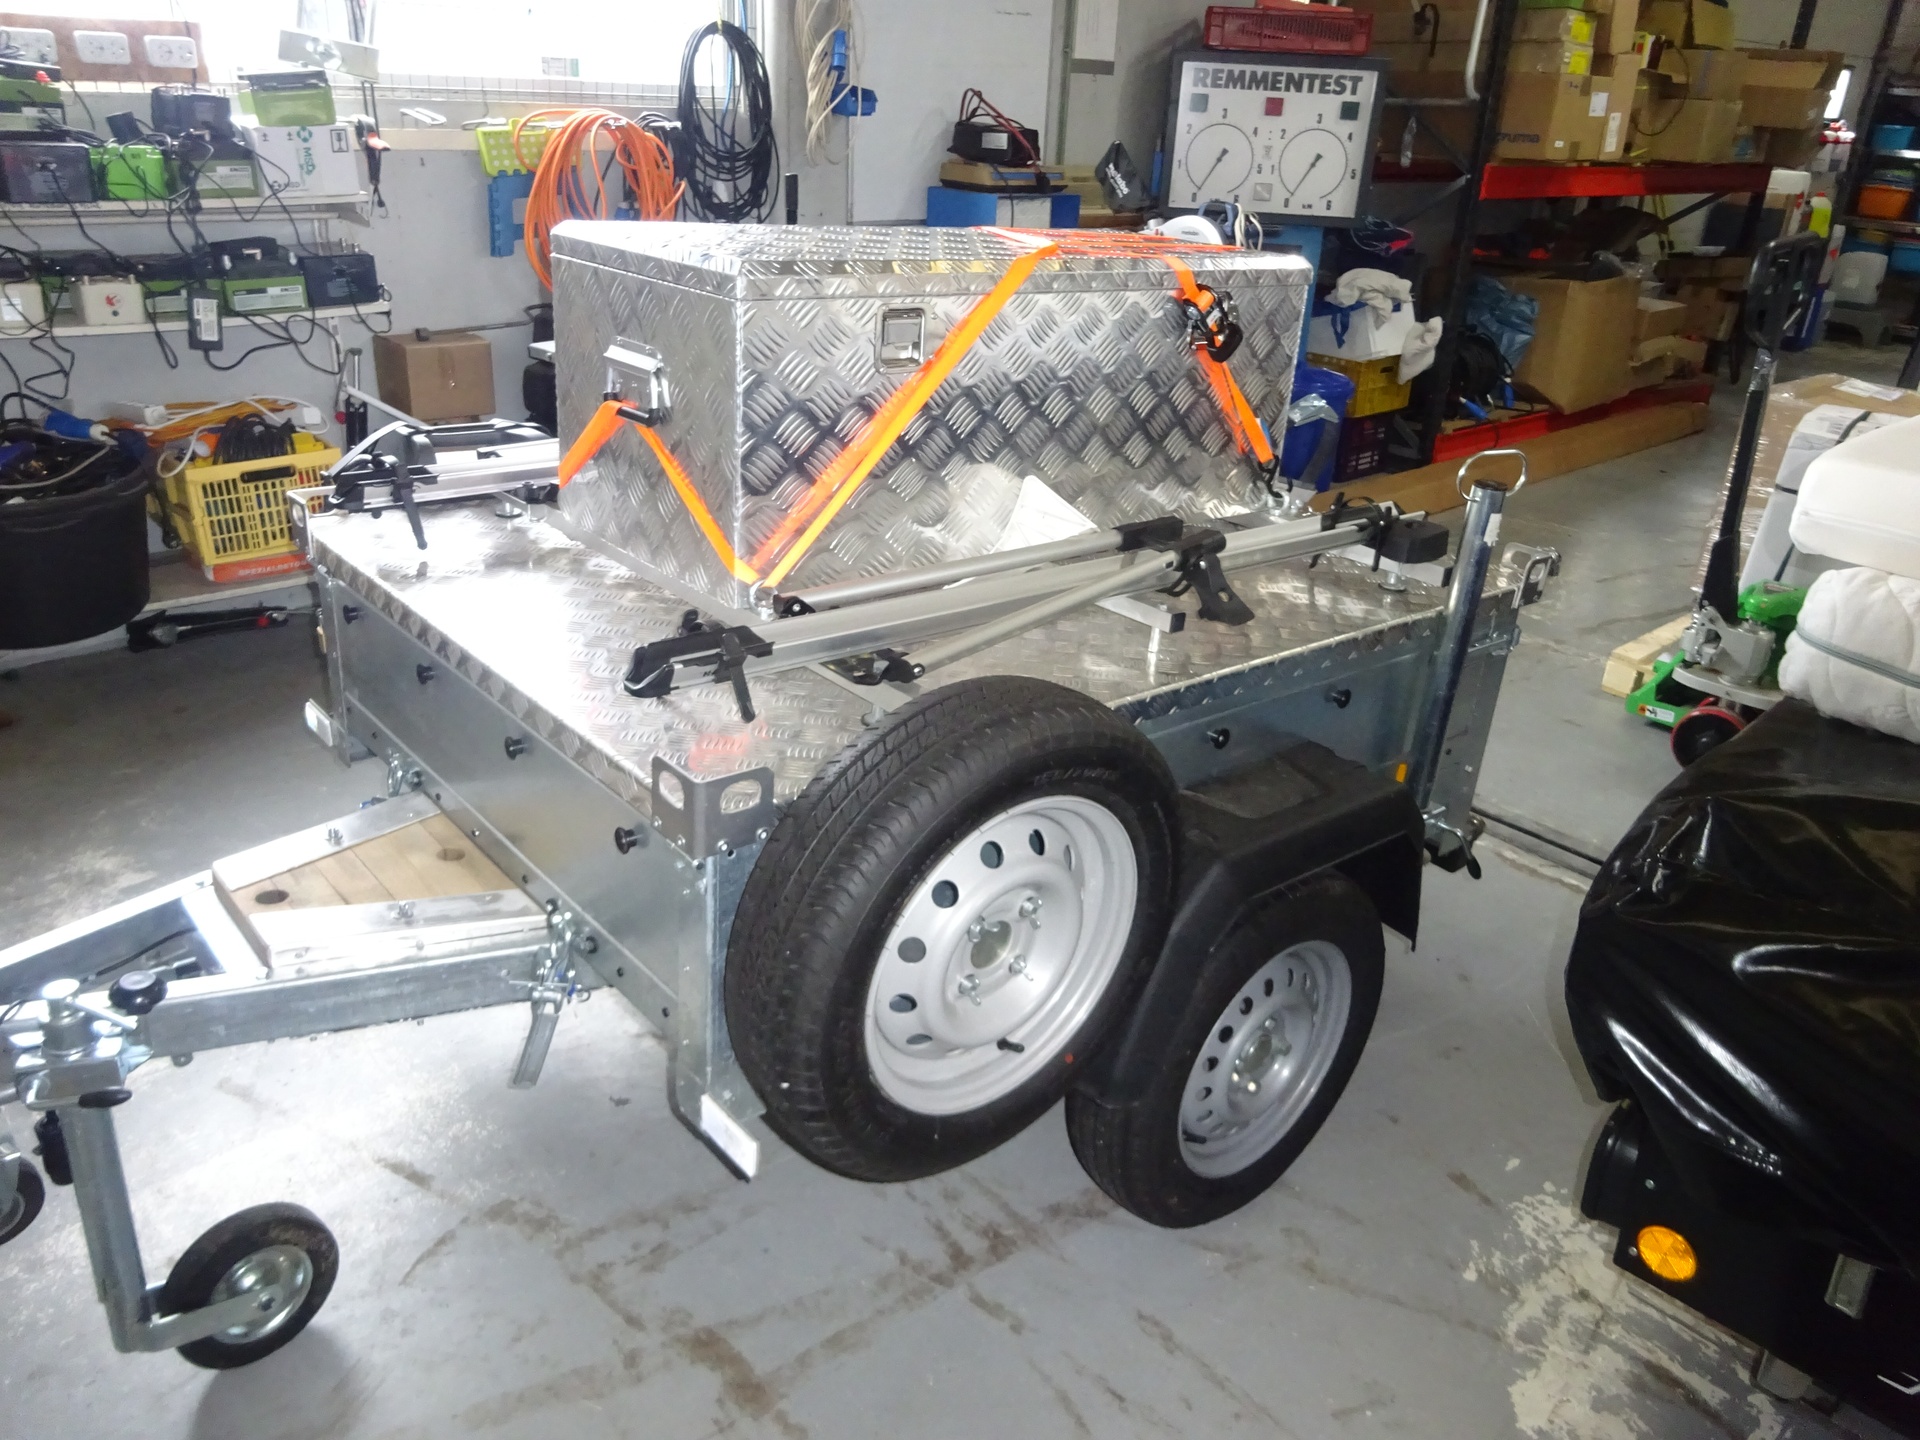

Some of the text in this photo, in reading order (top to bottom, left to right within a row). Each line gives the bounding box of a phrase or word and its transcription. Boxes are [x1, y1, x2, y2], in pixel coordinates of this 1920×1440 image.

[1192, 67, 1363, 96] REMMENTEST
[1222, 108, 1228, 119] 3
[1317, 114, 1323, 125] 3
[1186, 124, 1192, 134] 2
[1252, 127, 1258, 138] 4
[1280, 129, 1286, 139] 2
[1347, 132, 1353, 142] 4
[1177, 159, 1182, 169] 1
[1256, 164, 1262, 175] 5
[1270, 165, 1275, 175] 1
[1350, 169, 1356, 179] 5
[1191, 192, 1197, 203] 0
[1283, 198, 1289, 208] 0
[1326, 200, 1332, 211] 6
